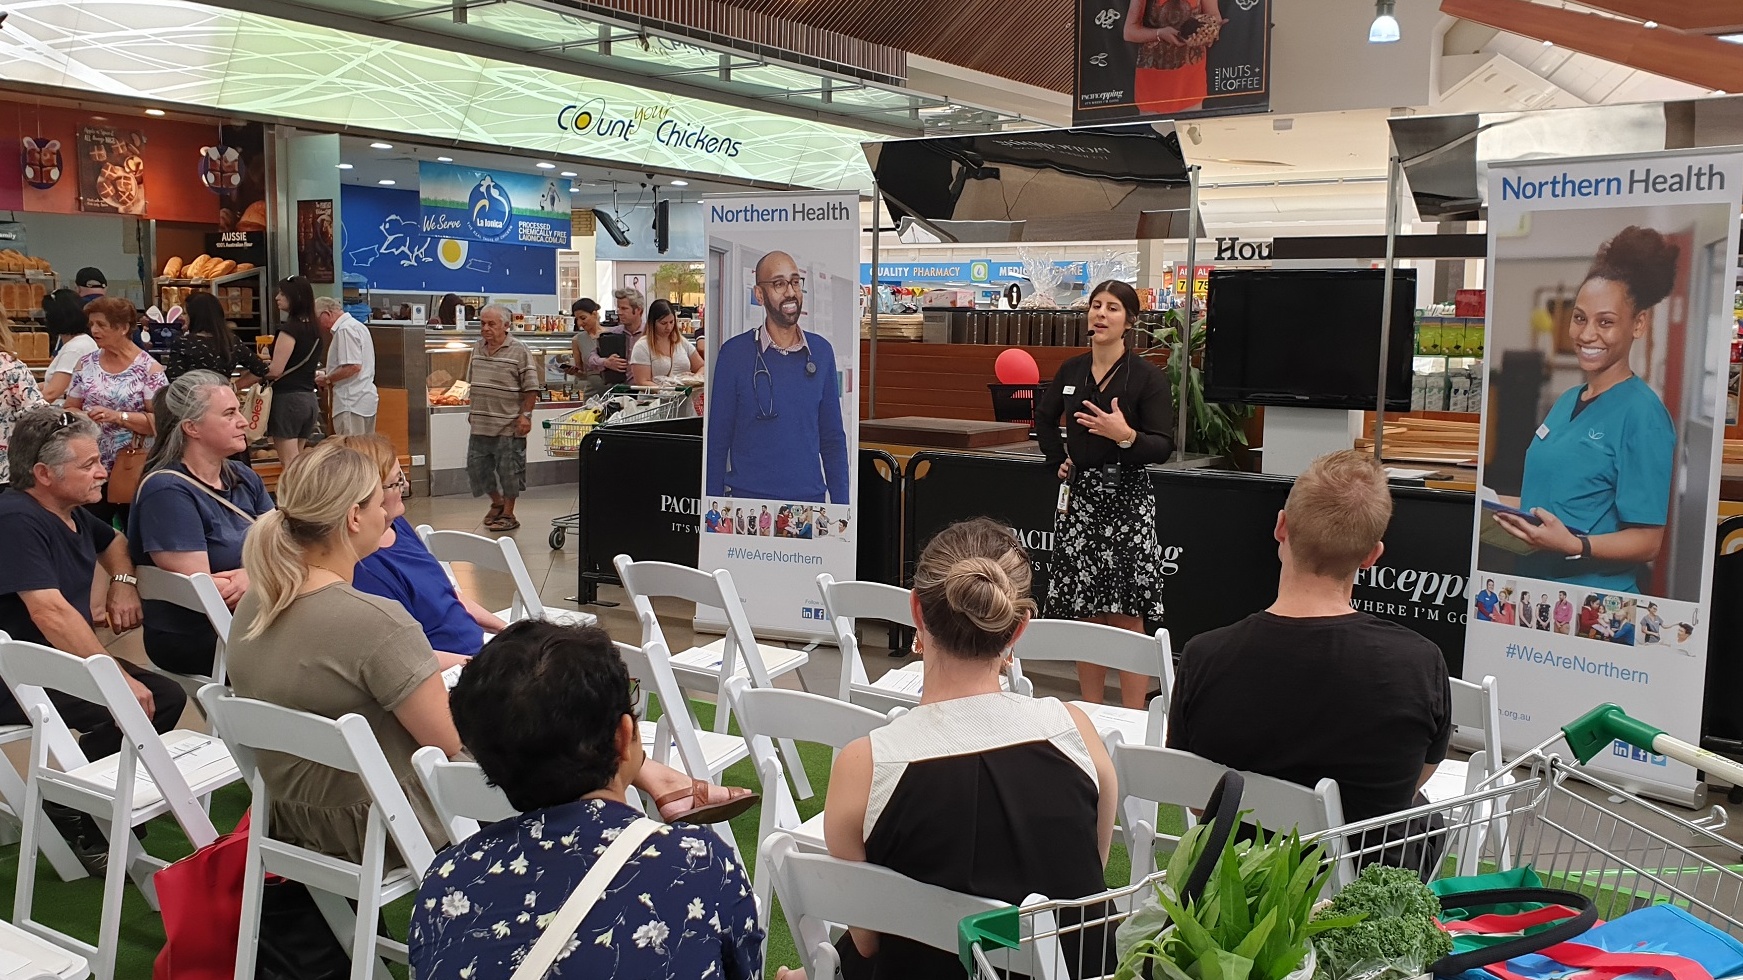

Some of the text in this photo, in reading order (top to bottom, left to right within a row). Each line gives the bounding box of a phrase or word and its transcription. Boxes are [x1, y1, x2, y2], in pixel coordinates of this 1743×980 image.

[1222, 64, 1251, 79] NUTS
[1221, 77, 1260, 91] COFFEE
[557, 98, 742, 157] Count Chickens
[628, 104, 674, 135] your
[1502, 163, 1725, 201] Northern Health
[711, 201, 850, 223] Northern Health
[422, 214, 462, 232] We Serve
[476, 218, 485, 227] La
[518, 220, 551, 231] PROCESSED
[221, 231, 248, 242] AUSSIE
[518, 228, 567, 239] CHEMICALLY FREE
[869, 266, 910, 277] UALITY
[912, 266, 960, 277] PHARMACY
[249, 398, 264, 431] coles
[672, 522, 690, 533] IT'S
[727, 546, 823, 565] #WeAreNorthern
[1350, 598, 1408, 617] WHERE
[1505, 642, 1650, 685] #WeAreNorthern
